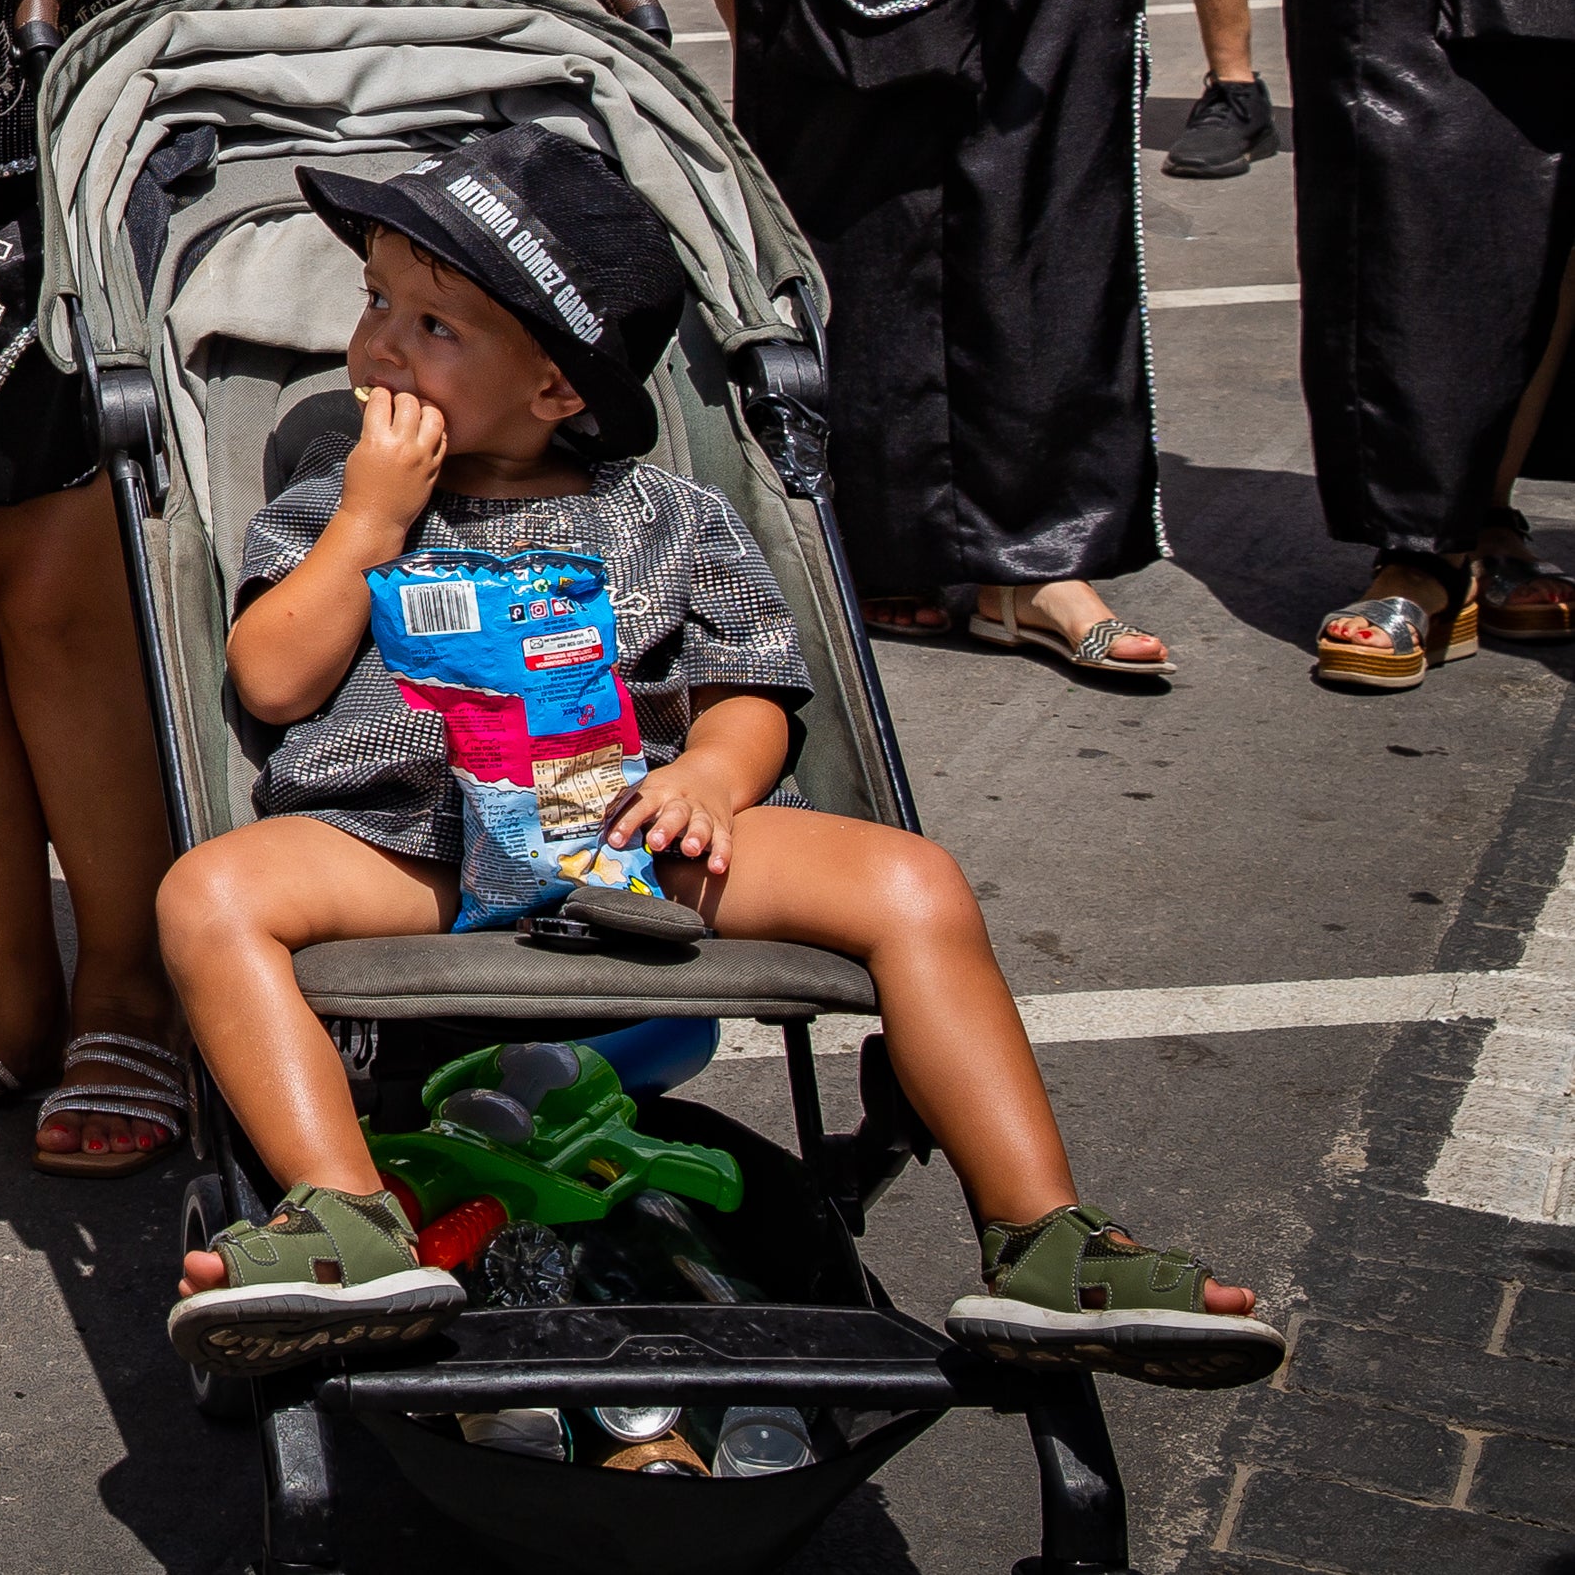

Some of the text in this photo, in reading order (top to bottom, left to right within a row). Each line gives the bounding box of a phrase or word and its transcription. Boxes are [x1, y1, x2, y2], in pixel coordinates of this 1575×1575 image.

[447, 175, 604, 345] ANTONIA GÓMEZ GARCÍA
